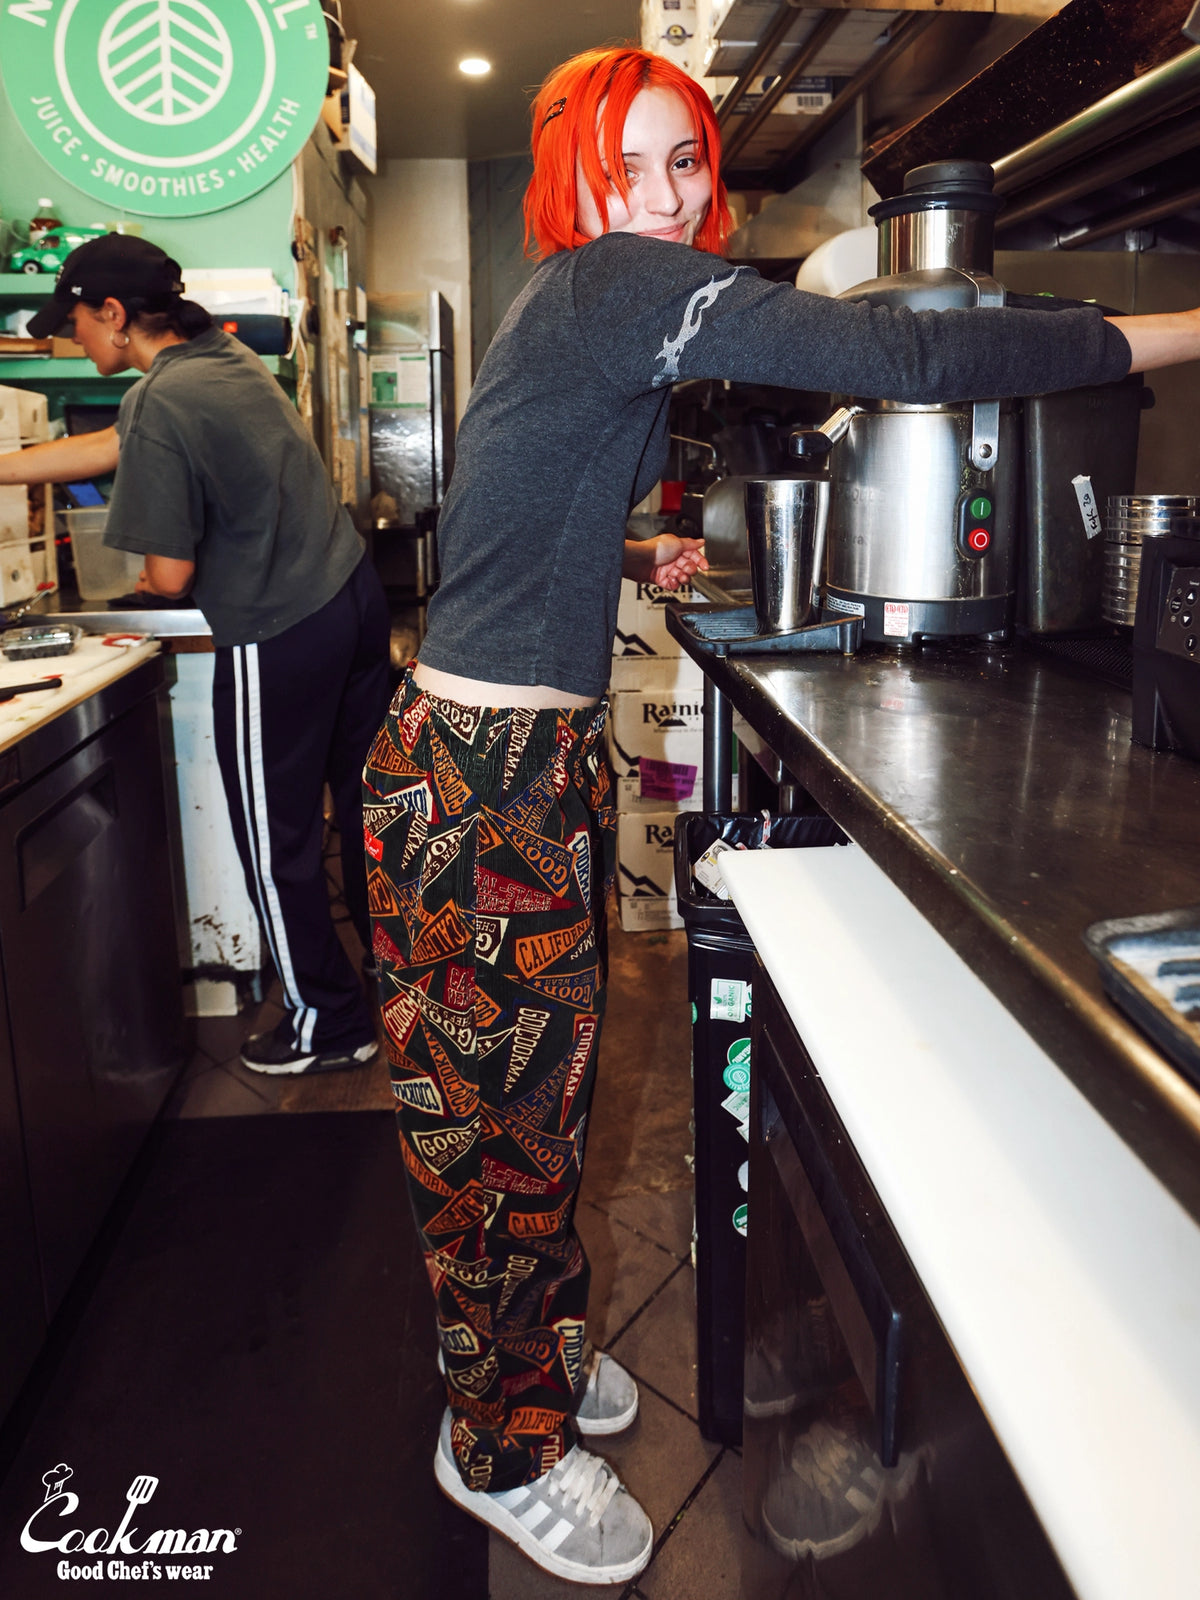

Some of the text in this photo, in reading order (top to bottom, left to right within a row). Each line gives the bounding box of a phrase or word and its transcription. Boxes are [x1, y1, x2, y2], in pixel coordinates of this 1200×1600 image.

[30, 95, 301, 197] JUICE SMOOTHIES HEALTH
[642, 700, 704, 725] Raini
[440, 841, 461, 862] WEA
[511, 834, 568, 885] GOOD
[477, 895, 510, 912] ENICE
[478, 872, 553, 907] AL-STATE
